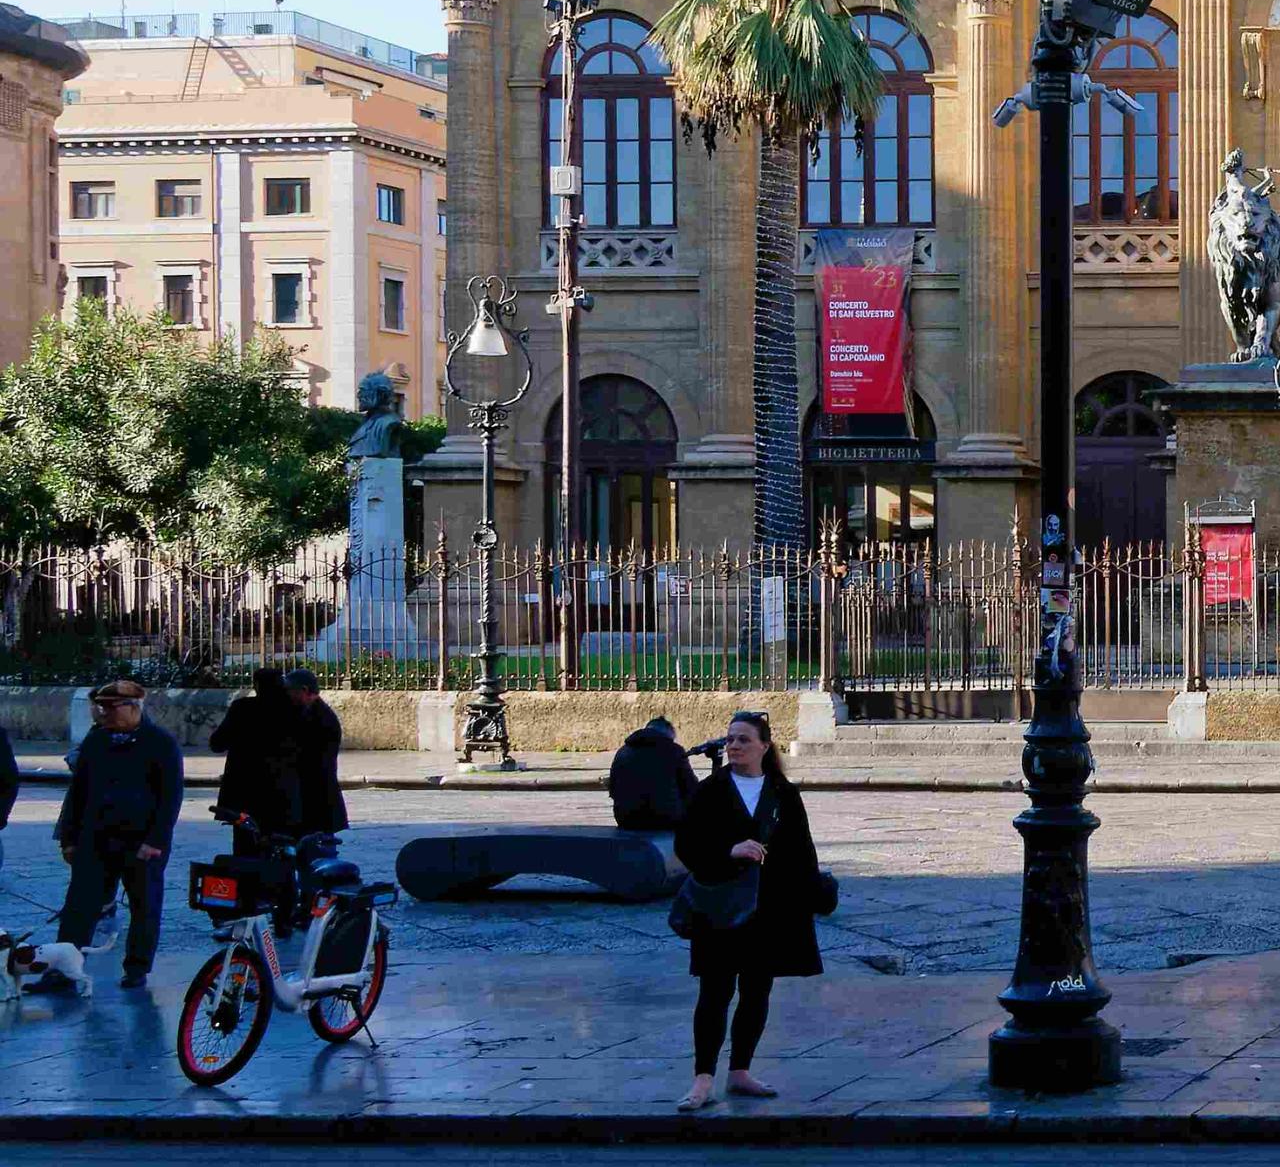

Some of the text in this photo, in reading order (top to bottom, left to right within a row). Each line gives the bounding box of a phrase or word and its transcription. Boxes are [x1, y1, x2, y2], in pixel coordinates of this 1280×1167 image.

[829, 301, 869, 310] CONCERTO
[829, 309, 895, 318] DI SAN SILVESTRO
[829, 344, 869, 353] CONCERTO
[830, 353, 885, 362] DI CAPODANNO
[818, 447, 921, 459] BIGLIETTERIA
